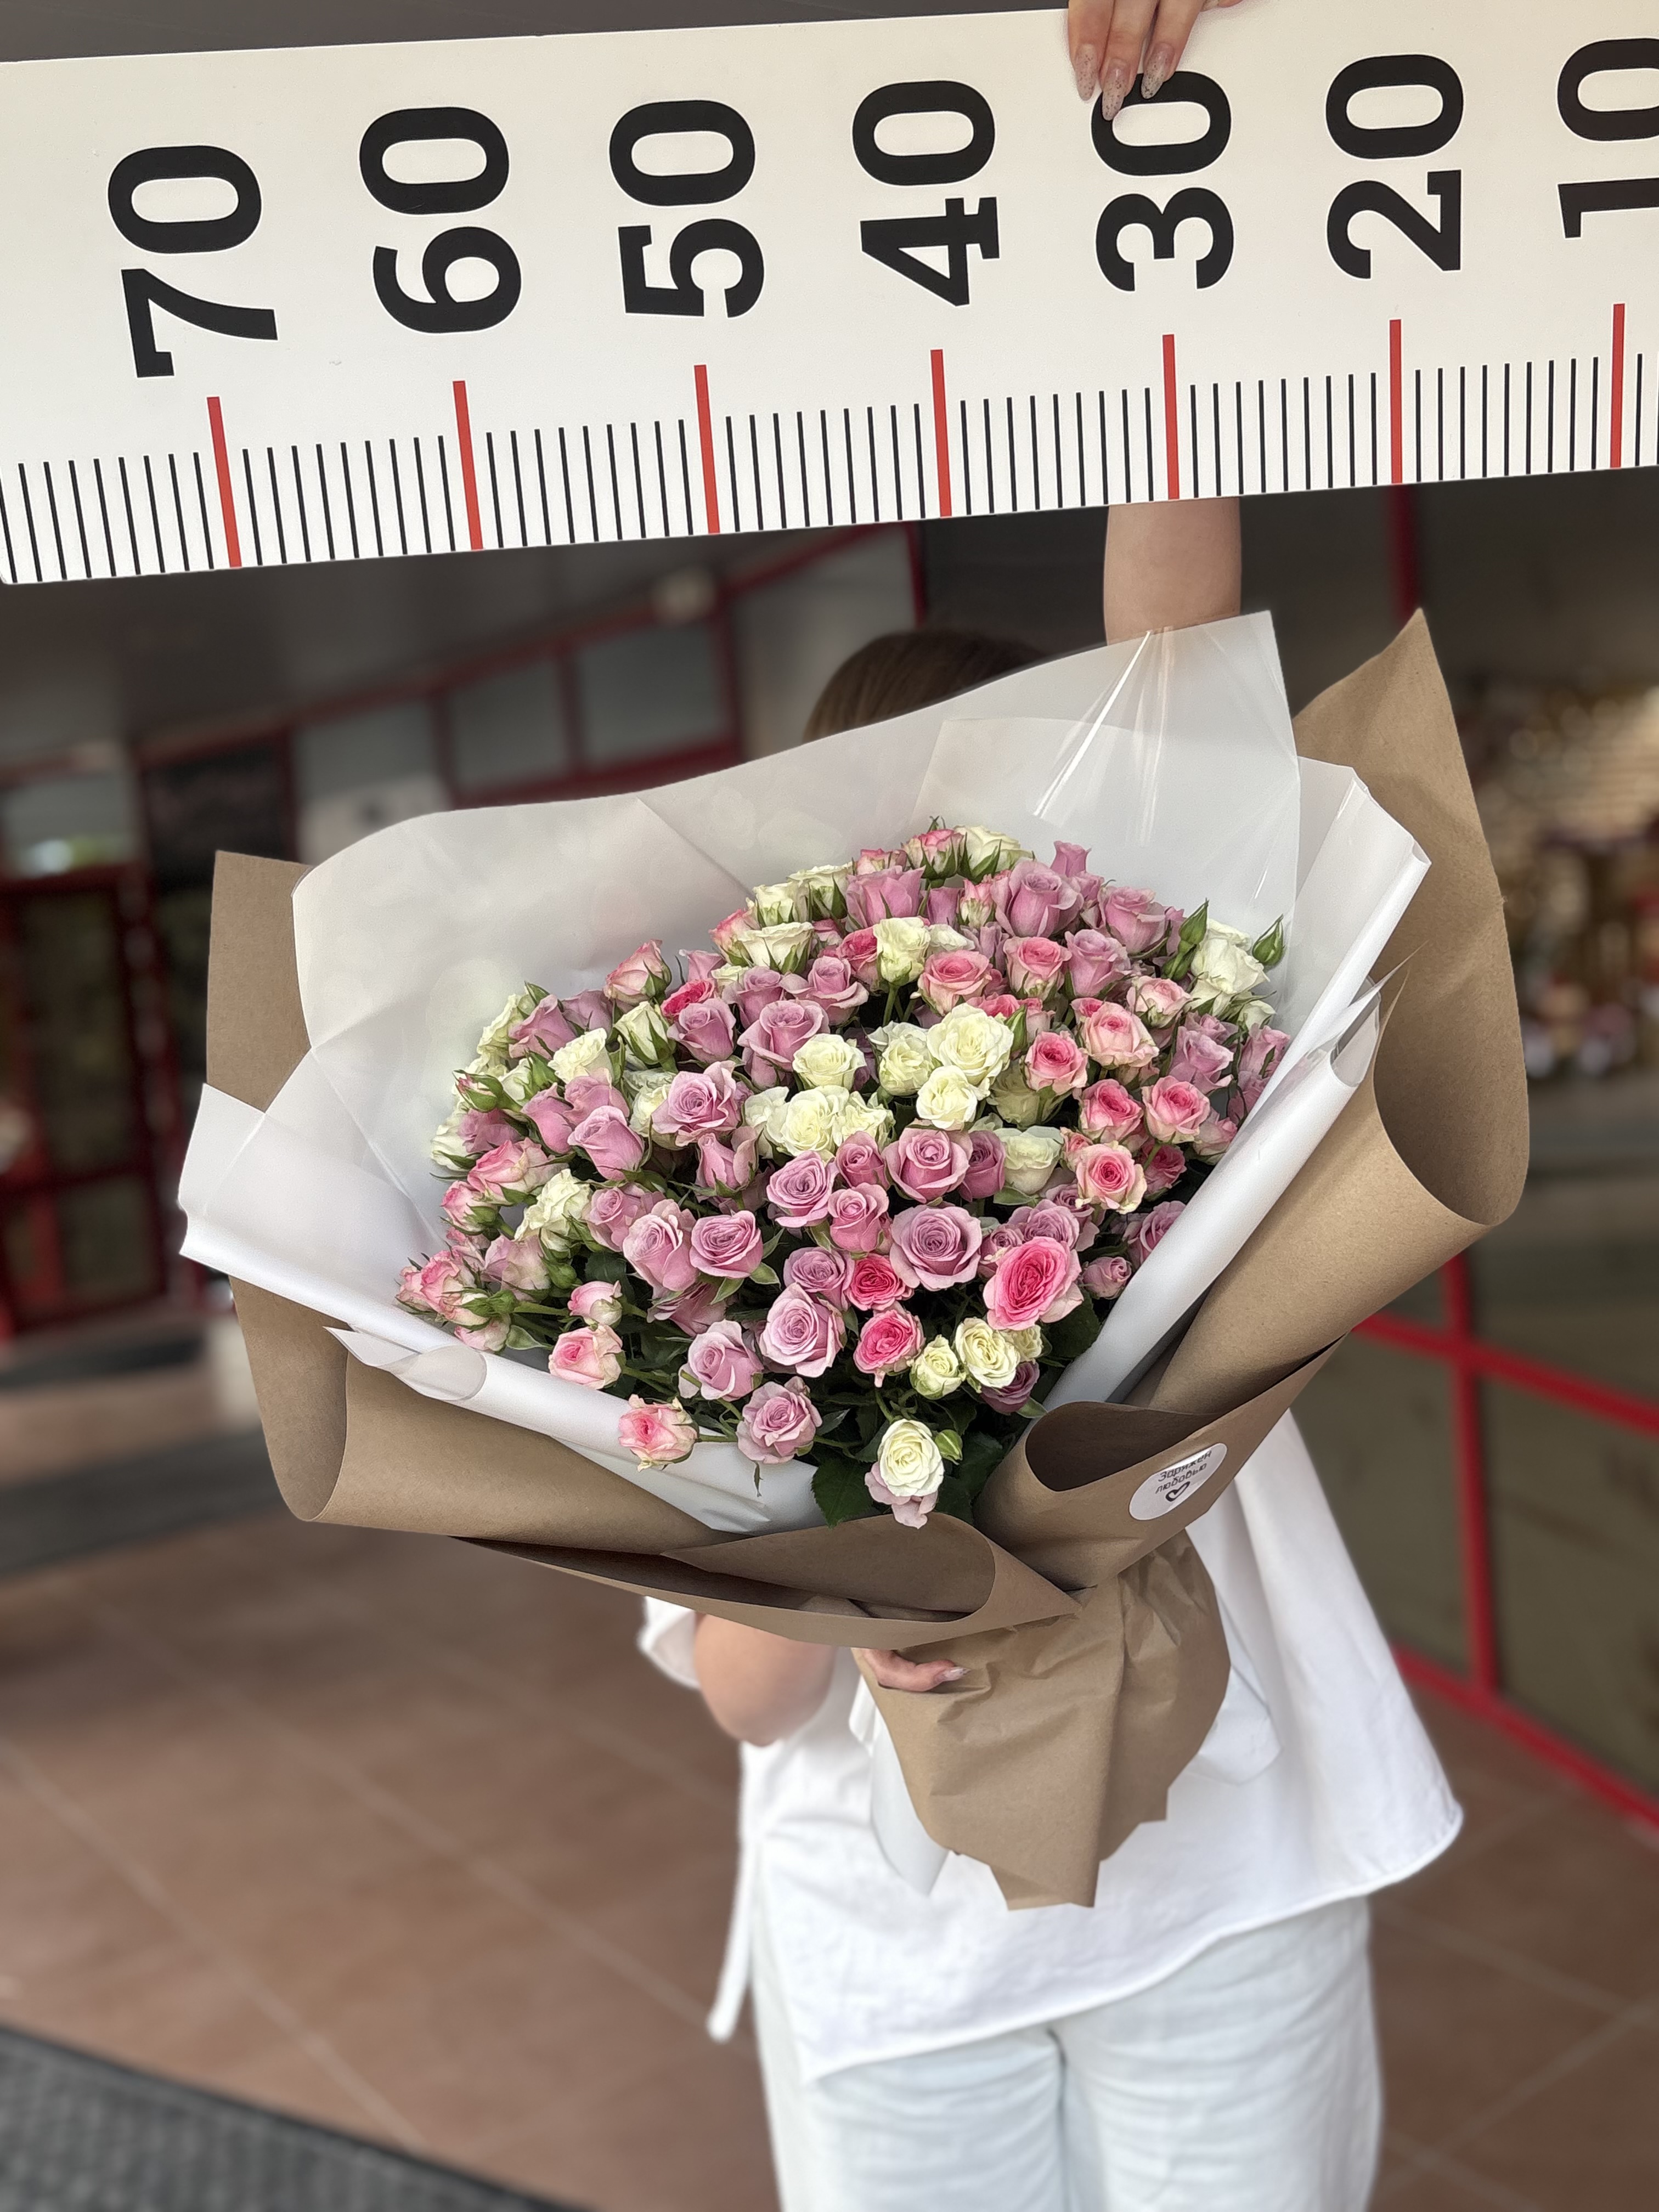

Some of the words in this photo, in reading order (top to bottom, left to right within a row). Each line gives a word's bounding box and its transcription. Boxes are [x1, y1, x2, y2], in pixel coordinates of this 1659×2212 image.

[358, 106, 522, 334] 60
[608, 99, 765, 318] 50
[851, 80, 1000, 307] 40
[1090, 70, 1234, 292] 30
[1325, 53, 1464, 280] 20
[1556, 37, 1659, 239] 10
[107, 144, 278, 379] 70
[1155, 1463, 1207, 1494] любовью
[1158, 1449, 1212, 1482] Заряжен
